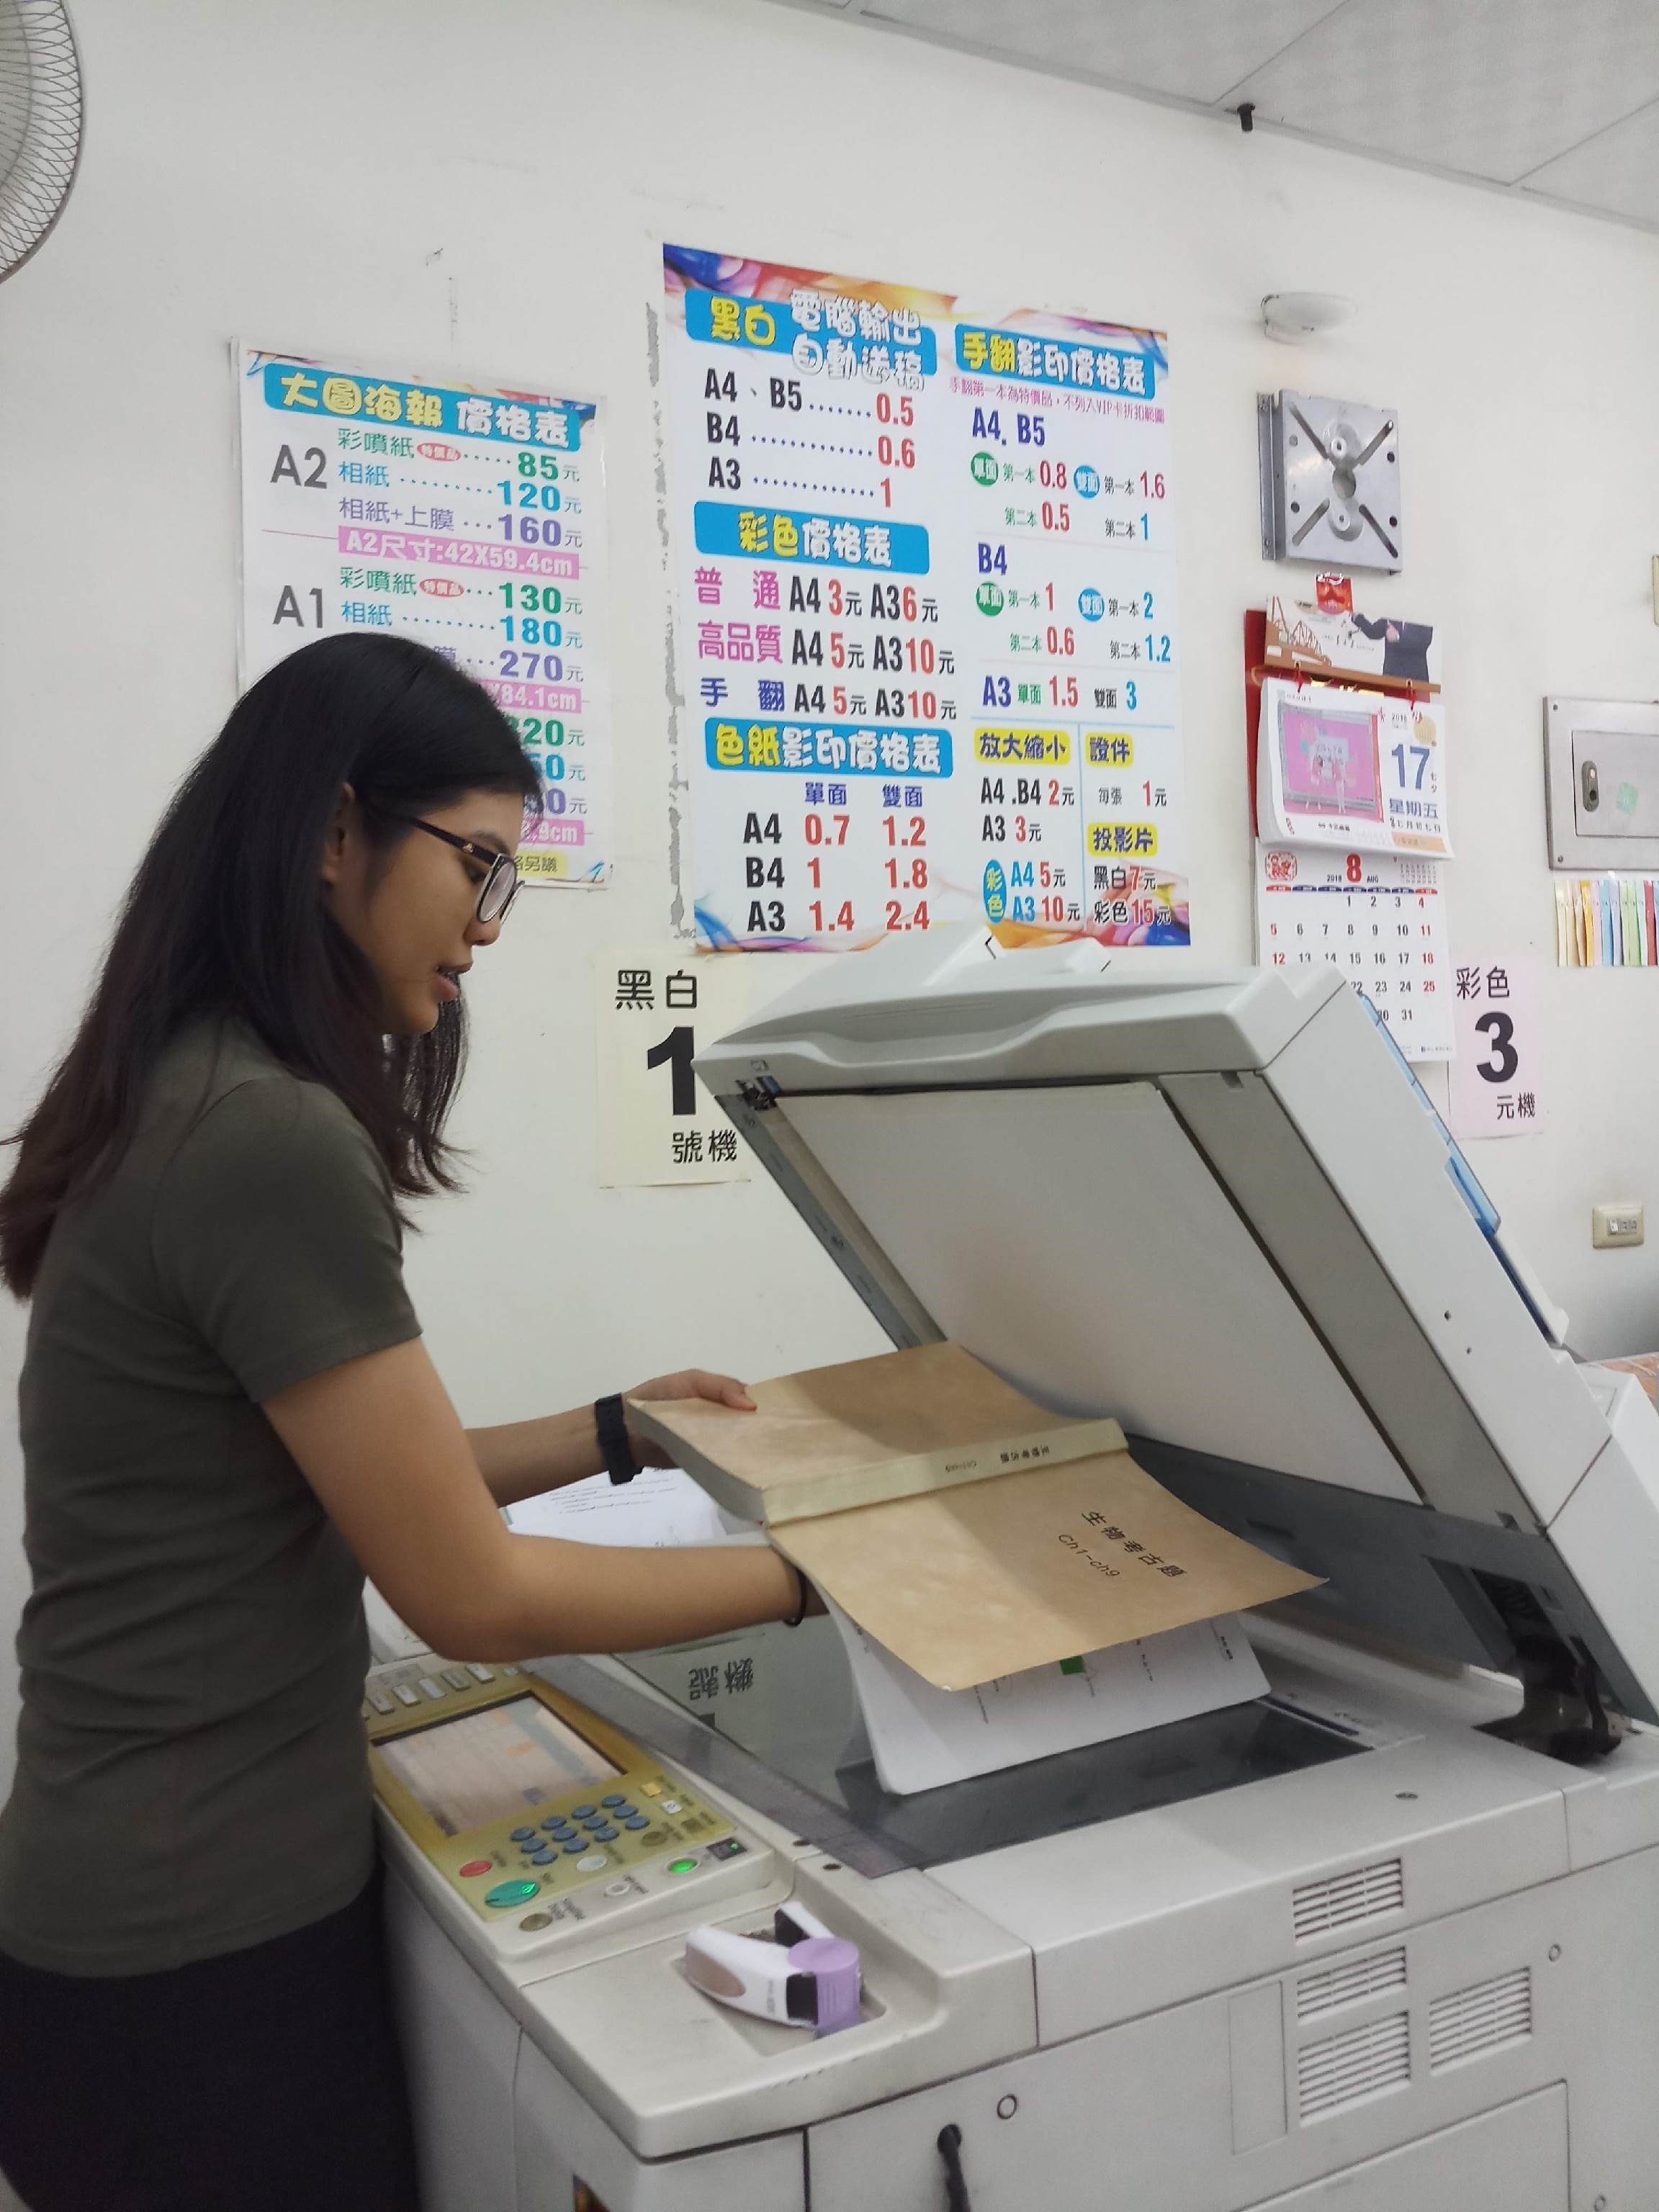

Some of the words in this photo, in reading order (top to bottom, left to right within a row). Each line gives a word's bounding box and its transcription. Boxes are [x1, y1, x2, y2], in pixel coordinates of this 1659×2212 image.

[711, 296, 775, 346] 黑白
[791, 289, 922, 346] 電腦輸出
[792, 333, 924, 391] 自動送稿
[281, 373, 442, 426] 大圖海報
[876, 392, 914, 426] 0.5
[338, 428, 414, 459] 彩噴紙
[707, 412, 740, 446] B4
[878, 436, 915, 468] 0.6
[1017, 413, 1045, 446] B5
[271, 444, 328, 488] A2
[338, 462, 389, 487] 相紙
[709, 457, 741, 490] A3
[880, 478, 891, 507] 1
[1040, 460, 1067, 490] 0.8
[1140, 471, 1165, 499] 1.6
[1042, 501, 1070, 531] 0.5
[1141, 513, 1148, 540] 1
[978, 541, 1007, 575] B4
[341, 567, 416, 596] 彩噴紙
[790, 576, 821, 613] A4
[273, 585, 323, 627] A1
[341, 601, 392, 626] 相紙
[1046, 583, 1053, 611] 1
[1143, 592, 1153, 619] 2
[698, 619, 782, 663] 高品質
[792, 629, 823, 666] A4
[1047, 626, 1074, 655] 0.6
[1145, 634, 1171, 662] 1.2
[794, 684, 825, 713] A4
[982, 675, 1011, 707] A3
[1017, 684, 1041, 704] 單面
[1049, 675, 1079, 706] 1.5
[1126, 680, 1137, 710] 3
[979, 732, 1066, 760] 放大縮小
[1089, 737, 1130, 763] 證件
[1392, 743, 1430, 791] 17
[805, 782, 846, 805] 單面
[883, 784, 922, 808] 雙面
[1390, 799, 1438, 819] 星期五
[743, 813, 782, 845] A4
[805, 814, 850, 846] 0.7
[883, 816, 927, 847] 1.2
[982, 814, 1006, 842] A3
[1093, 827, 1154, 853] 投影片
[745, 858, 785, 889] B4
[807, 858, 821, 889] 1
[885, 858, 928, 889] 1.8
[1011, 862, 1034, 888] A4
[1346, 853, 1362, 883] 8
[747, 902, 786, 932] A3
[809, 902, 855, 932] 1.4
[885, 902, 930, 931] 2.4
[1012, 896, 1035, 922] A3
[1347, 896, 1352, 907] 1
[1370, 896, 1377, 907] 2
[1395, 896, 1401, 907] 3
[1419, 897, 1424, 908] 4
[1297, 923, 1303, 935] 6
[1323, 924, 1328, 935] 7
[1348, 924, 1354, 935] 8
[1372, 924, 1378, 936] 9
[1397, 925, 1408, 936] 10
[1421, 925, 1431, 936] 11
[1273, 953, 1285, 965] 12
[1350, 953, 1361, 964] 15
[1375, 953, 1385, 964] 16
[1398, 953, 1409, 964] 17
[615, 969, 697, 1010] 黑白
[1375, 981, 1387, 992] 23
[1400, 981, 1411, 992] 24
[1424, 981, 1435, 992] 25
[1456, 966, 1510, 1000] 彩色
[1402, 1010, 1412, 1020] 31
[1475, 1011, 1519, 1083] 3
[647, 1025, 696, 1116] 1
[1496, 1092, 1536, 1120] 元機
[672, 1129, 737, 1164] 號機
